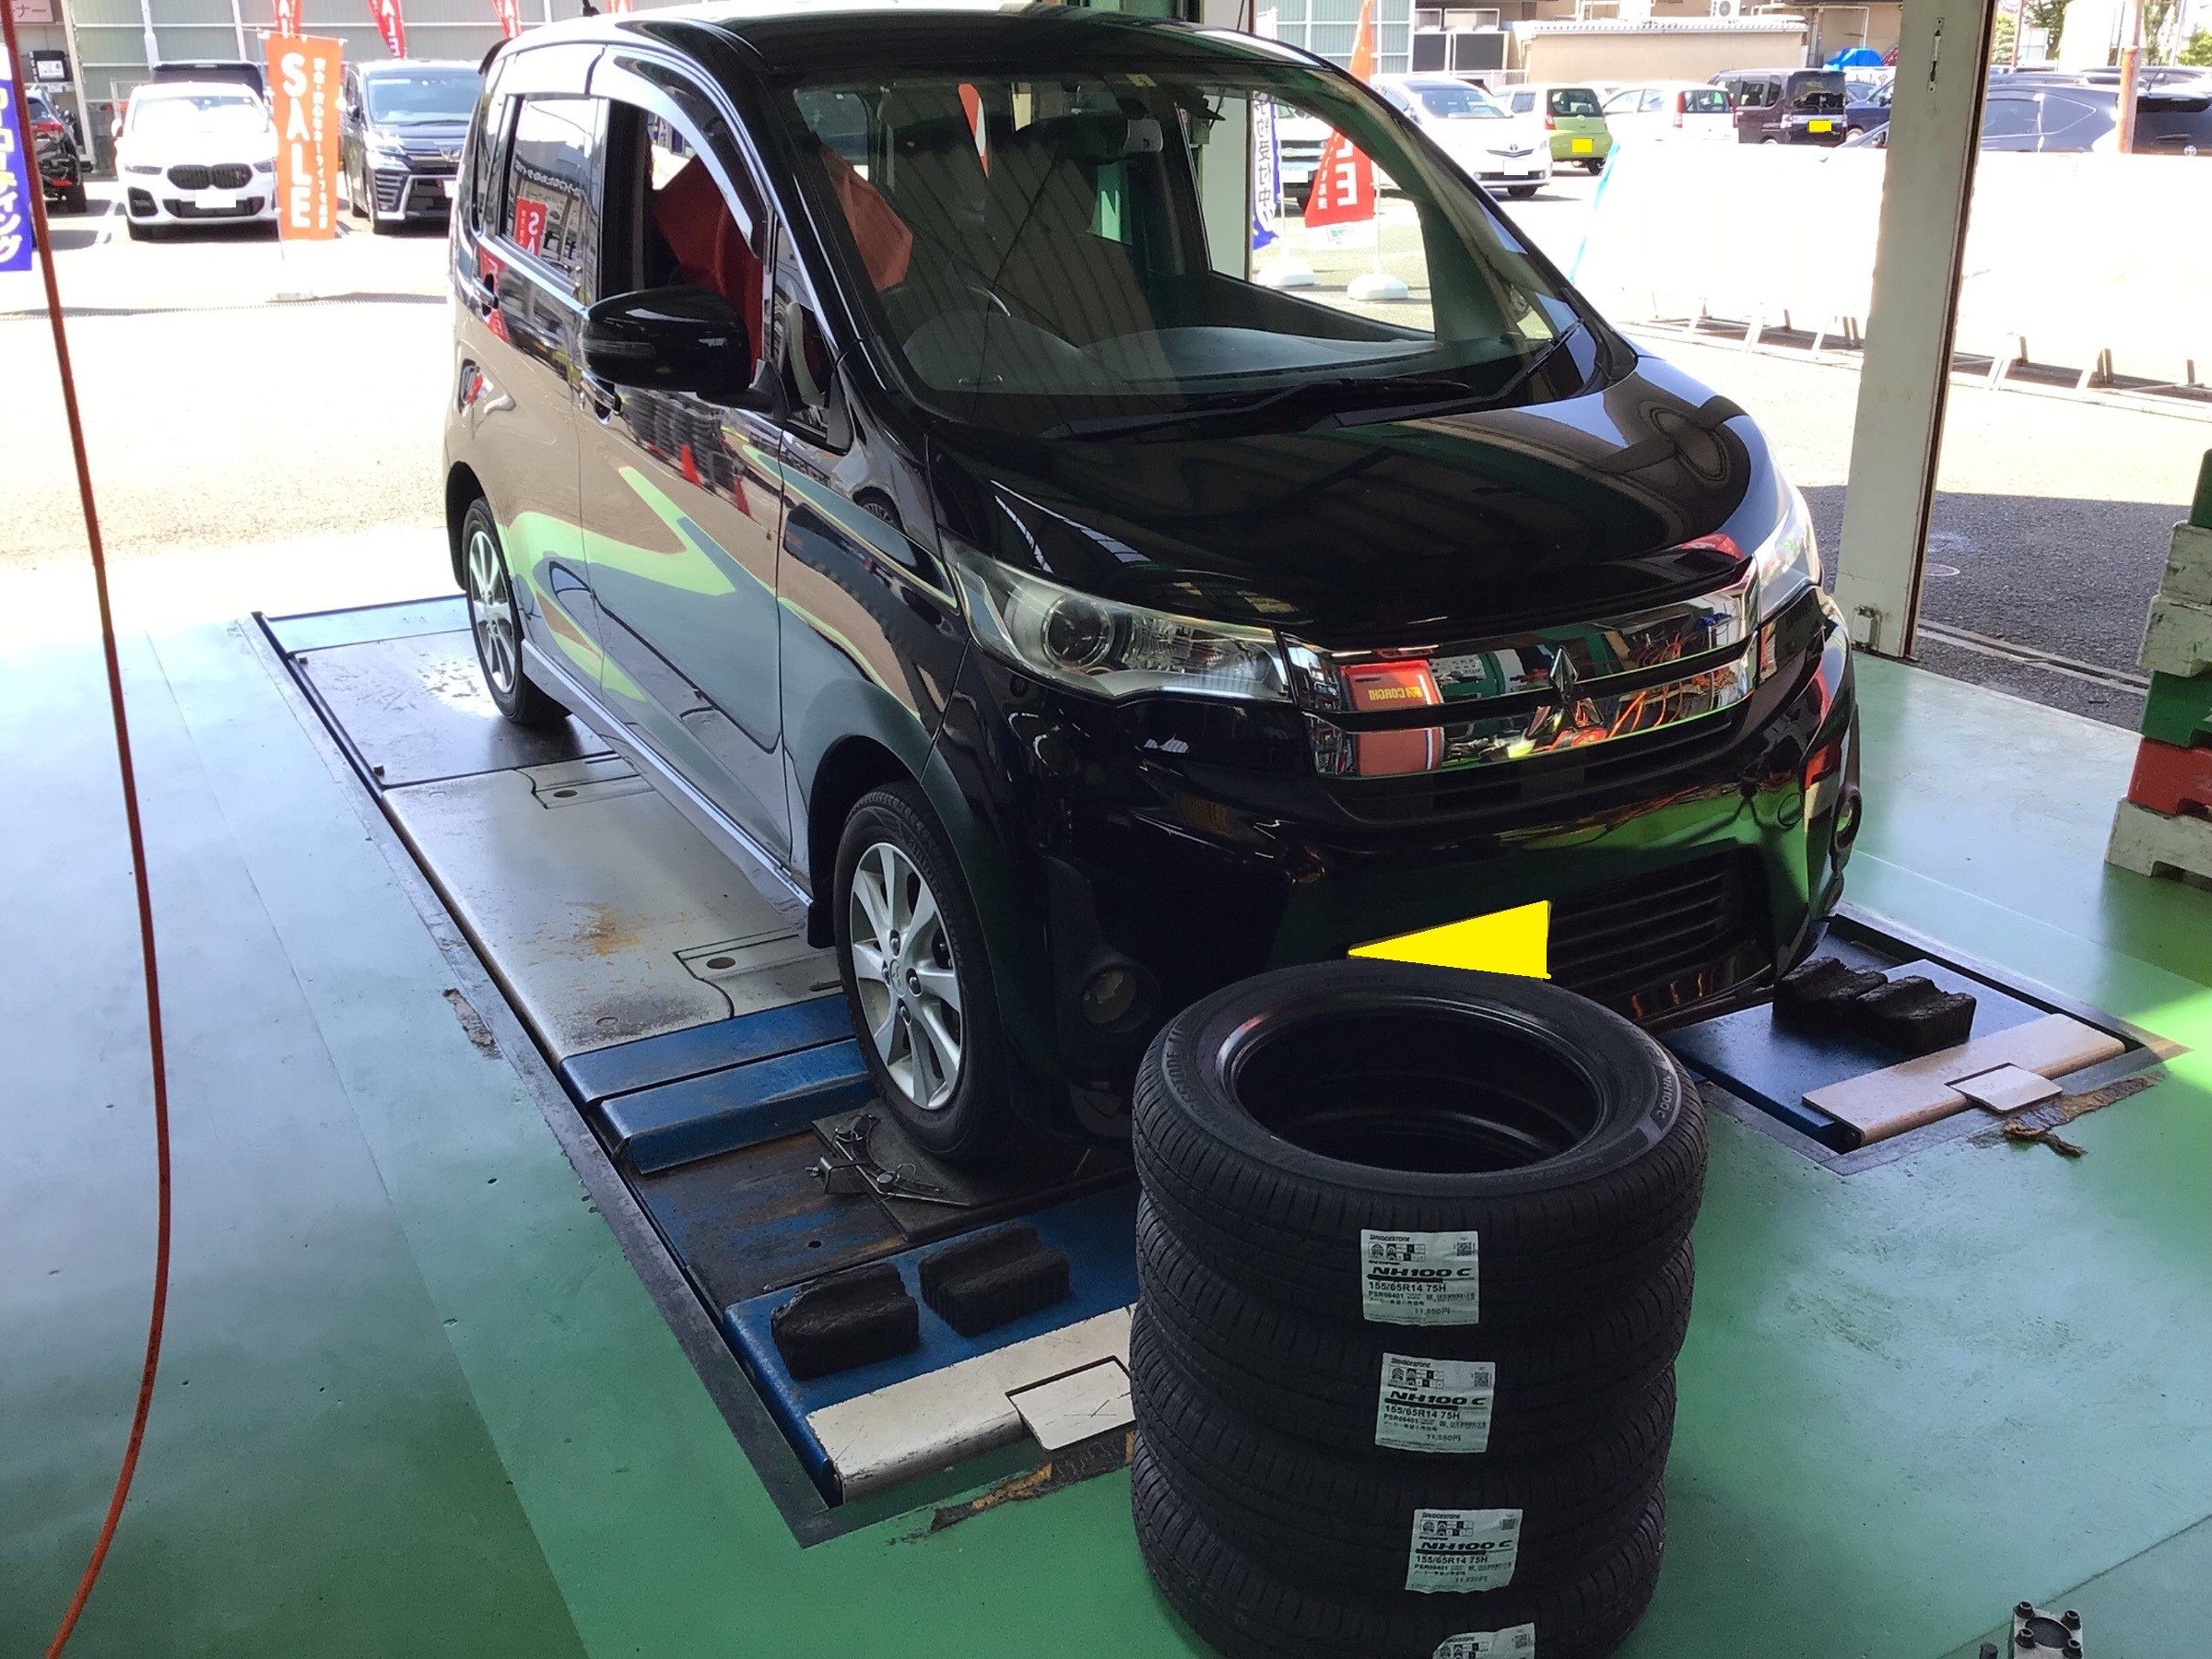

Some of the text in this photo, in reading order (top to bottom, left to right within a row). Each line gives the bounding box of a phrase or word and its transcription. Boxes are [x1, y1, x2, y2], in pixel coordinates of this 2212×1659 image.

[281, 52, 312, 229] SALE
[1371, 1266, 1472, 1277] NH100 C
[1369, 1281, 1447, 1292] 155/65R14 75H
[1390, 1391, 1487, 1406] NH100 C
[1384, 1405, 1460, 1419] 155/65R14 75H
[1420, 1539, 1512, 1550] NH100 C
[1416, 1555, 1488, 1564] 155/65R14 75H
